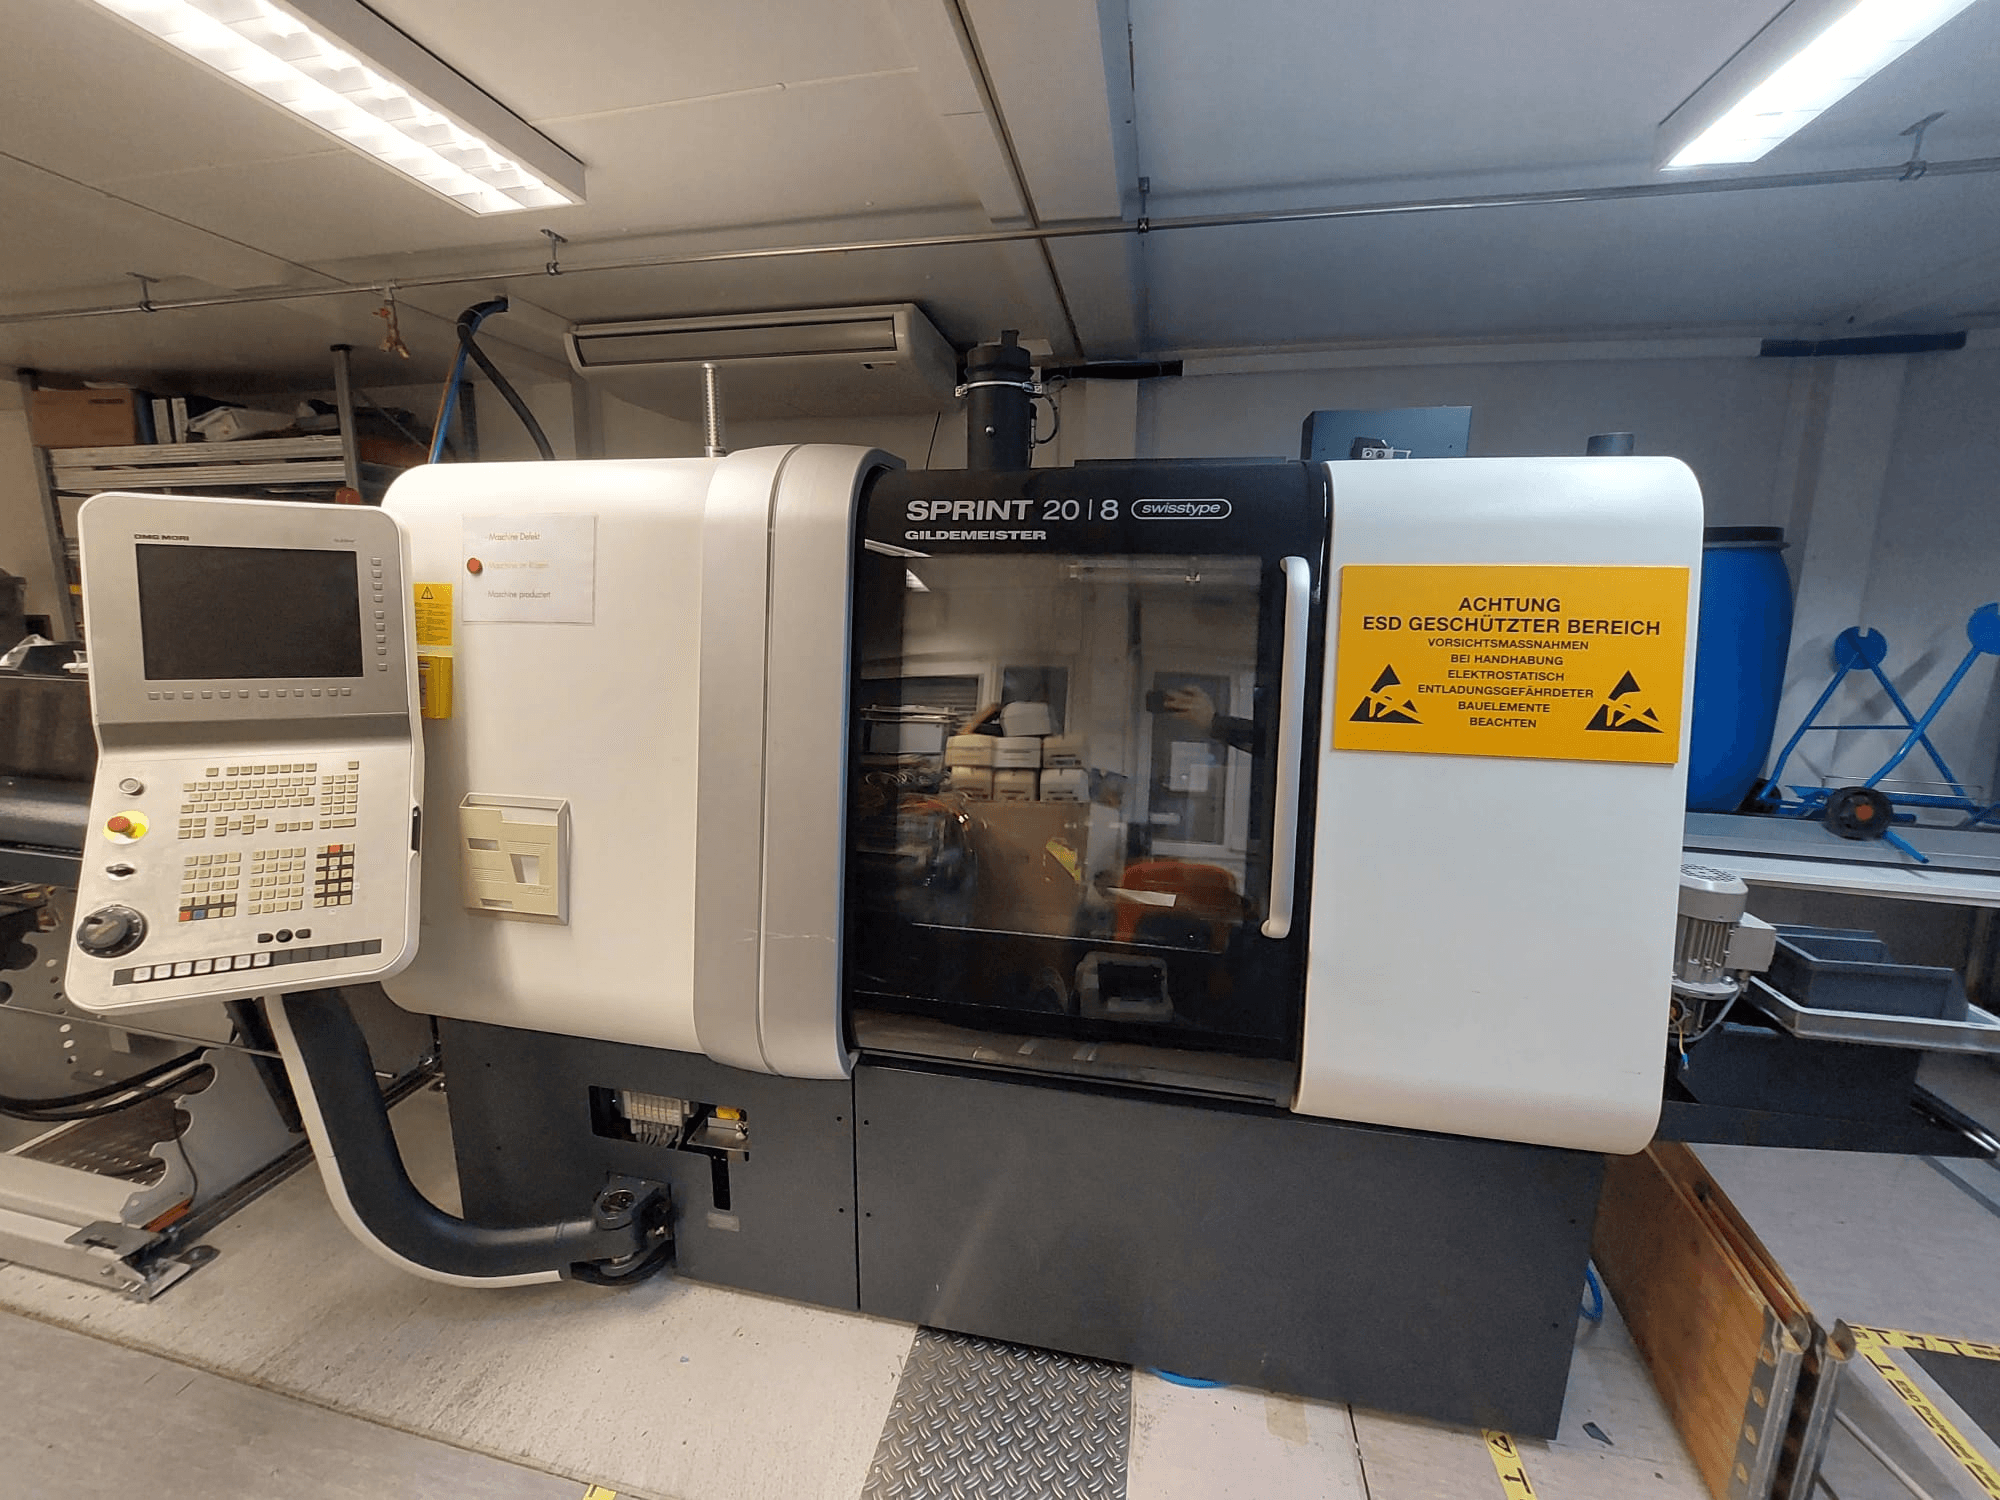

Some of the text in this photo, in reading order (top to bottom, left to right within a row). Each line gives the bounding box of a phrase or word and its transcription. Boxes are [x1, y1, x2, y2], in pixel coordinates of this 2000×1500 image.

[906, 499, 1034, 521] SPRINT
[1141, 501, 1222, 516] swisstype
[904, 530, 1047, 541] GILDEMEISTER
[1458, 596, 1561, 612] ACHTUNG
[1363, 614, 1660, 635] ESD GESCHÜTZTER BEREICH
[1428, 638, 1589, 650] VORSICHTSMASSNAHMEN
[1450, 654, 1564, 666] BEI HANDHABUNG
[1447, 670, 1564, 682] ELEKTROSTATISCH
[1417, 684, 1594, 699] ENTLADUNGSGEFÄHRDETER
[1458, 701, 1550, 713] BAUELEMENTE
[1469, 717, 1537, 728] BEACHTEN
